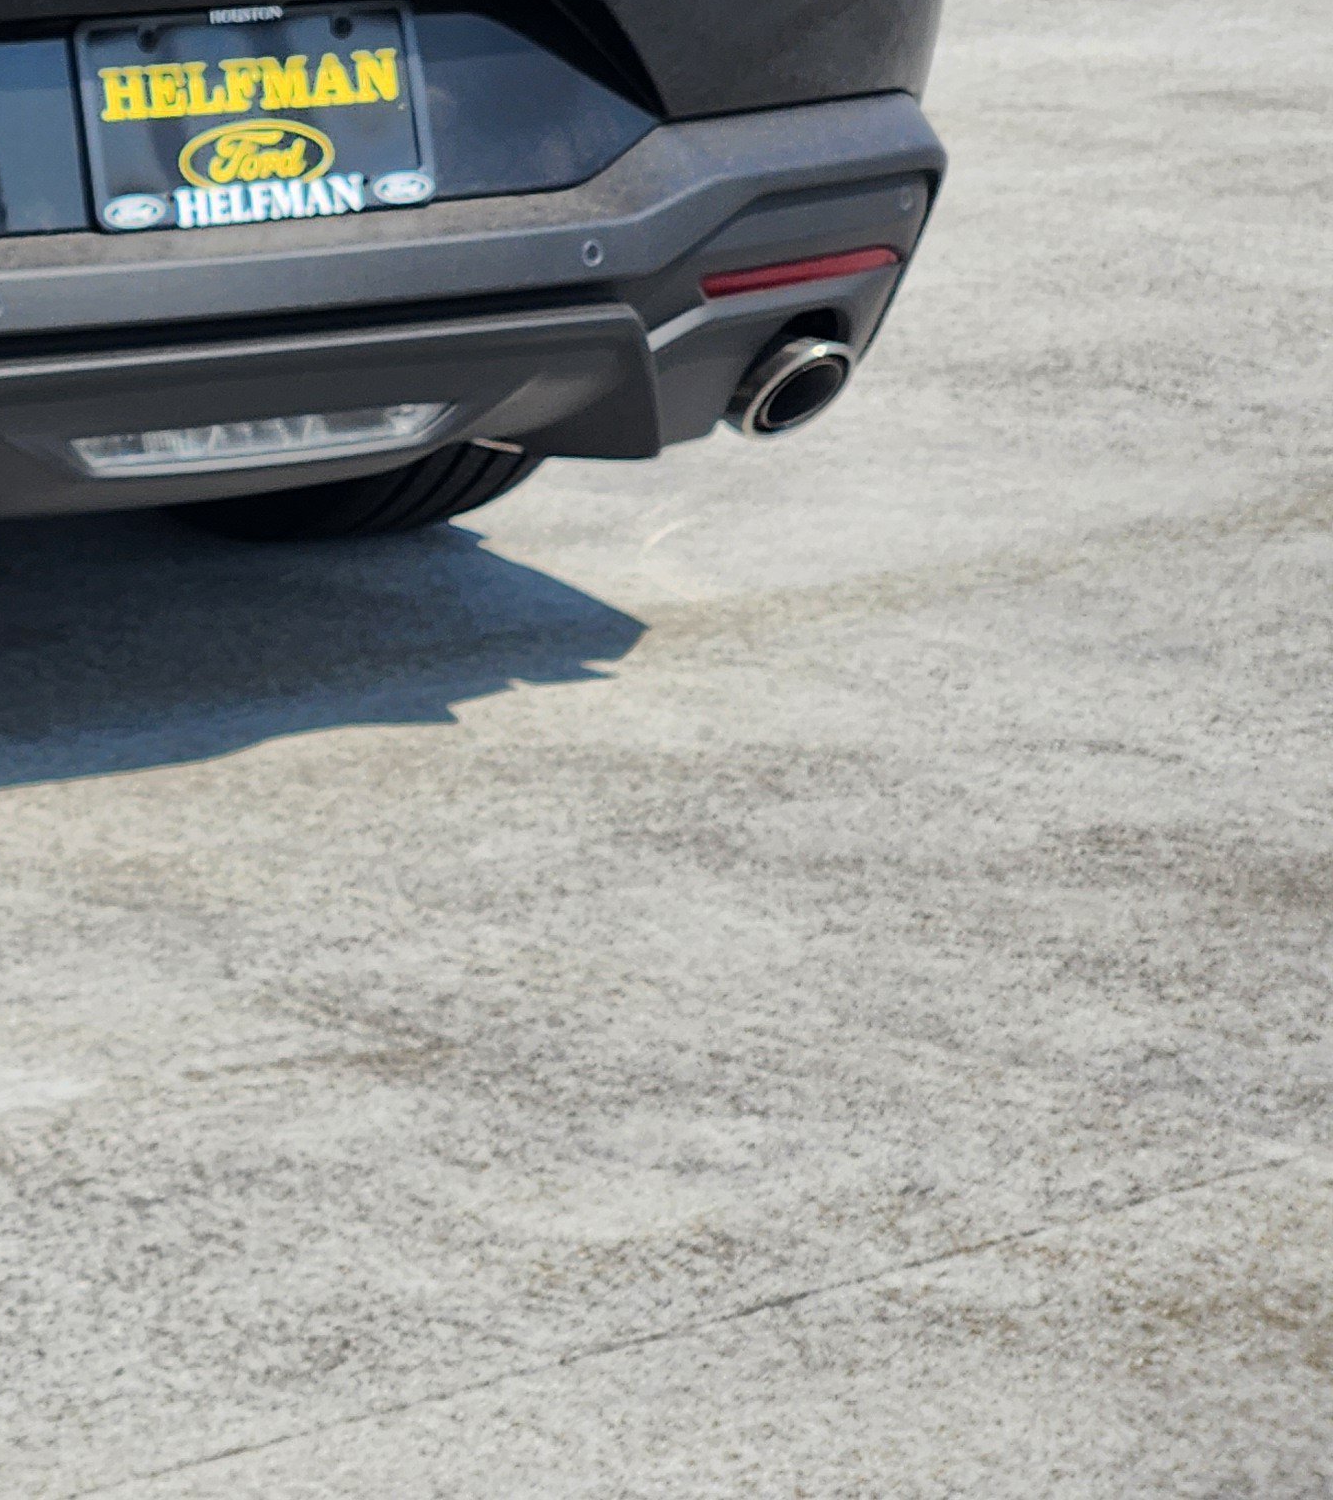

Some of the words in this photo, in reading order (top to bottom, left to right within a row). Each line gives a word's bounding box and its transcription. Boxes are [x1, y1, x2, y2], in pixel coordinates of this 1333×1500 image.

[209, 5, 283, 24] HOUSTON
[97, 48, 398, 122] HELFMAN
[208, 130, 308, 183] Ford
[172, 172, 365, 229] HELFMAN
